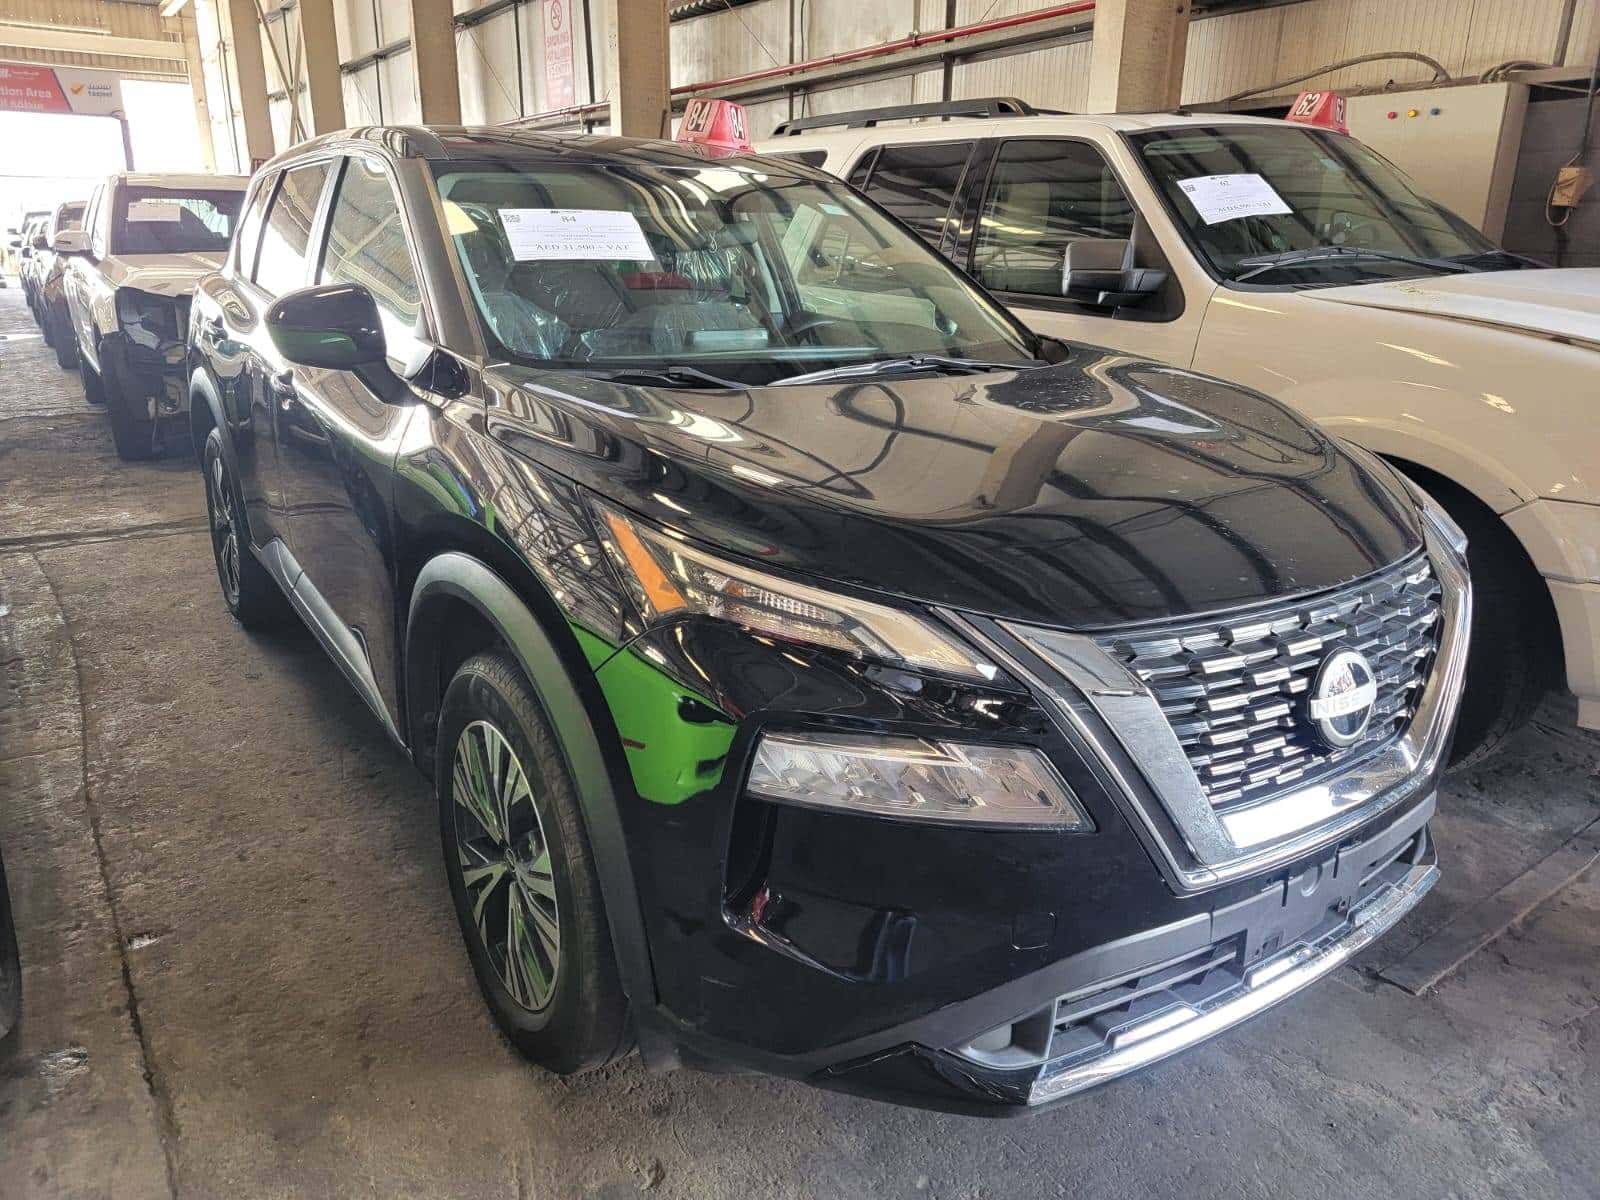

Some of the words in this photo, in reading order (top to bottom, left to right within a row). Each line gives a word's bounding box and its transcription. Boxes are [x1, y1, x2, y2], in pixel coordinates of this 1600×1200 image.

[26, 87, 52, 98] Area
[1296, 93, 1320, 116] 62
[687, 101, 712, 132] 84
[1335, 98, 1344, 123] 62
[730, 106, 745, 140] 84
[561, 215, 576, 223] 84
